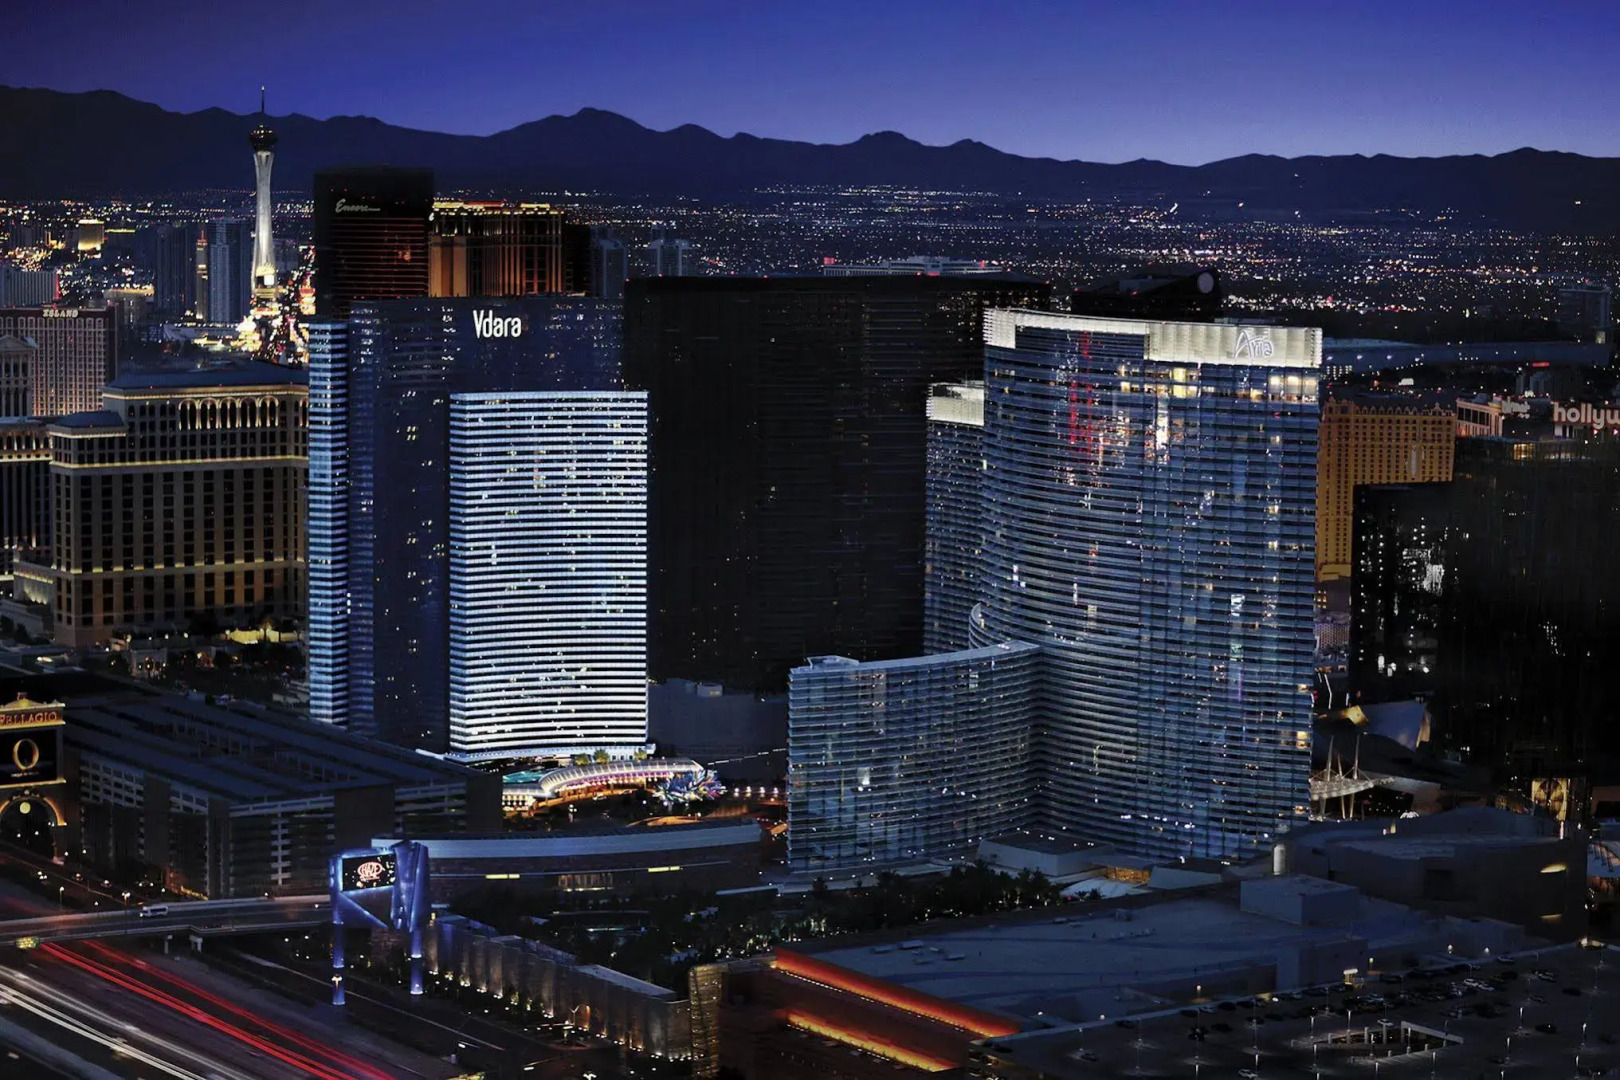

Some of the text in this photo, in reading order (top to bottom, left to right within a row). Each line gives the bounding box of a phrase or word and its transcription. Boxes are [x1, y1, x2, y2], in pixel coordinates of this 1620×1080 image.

[42, 309, 79, 318] ISLAND
[472, 309, 522, 339] Vdara
[1233, 330, 1274, 358] Aria
